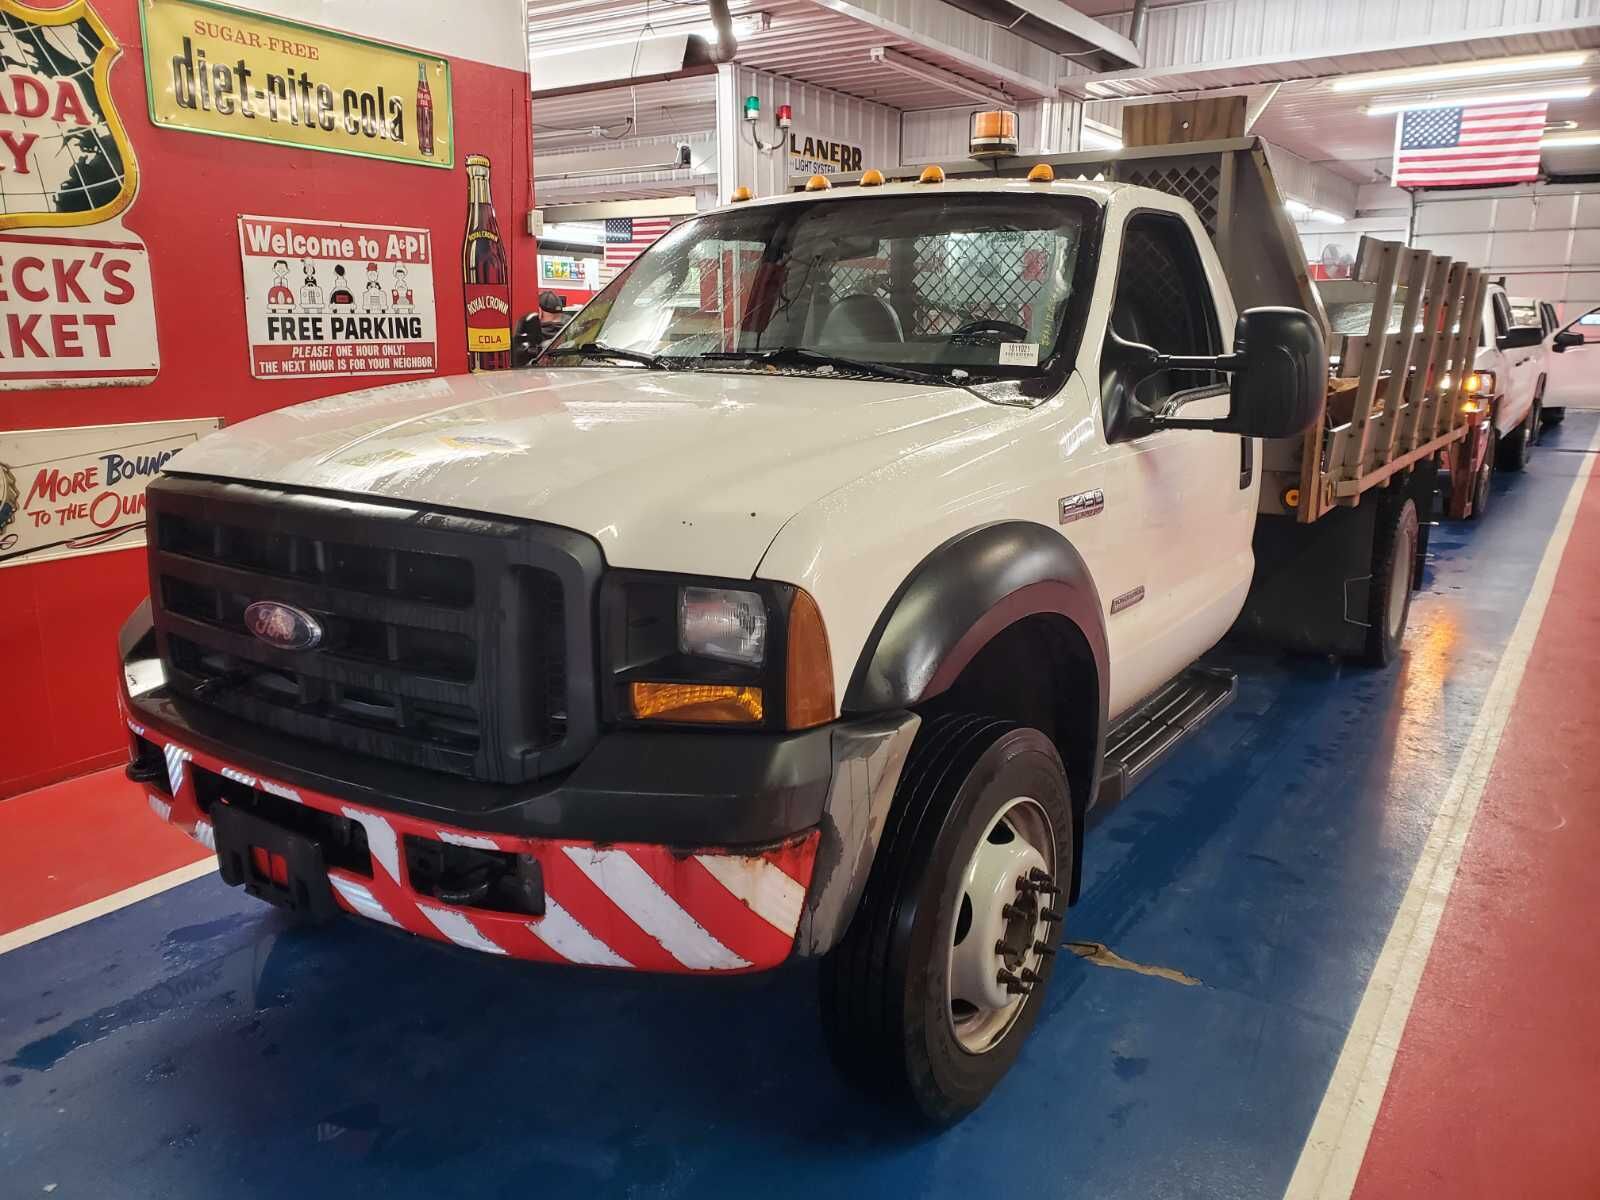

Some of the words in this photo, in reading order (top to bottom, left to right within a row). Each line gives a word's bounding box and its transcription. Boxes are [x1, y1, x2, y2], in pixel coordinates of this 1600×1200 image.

[194, 20, 319, 61] SUGAR-FREE
[172, 35, 336, 132] diet-rite
[342, 86, 404, 142] cola
[795, 158, 813, 171] LIGHT
[813, 161, 836, 174] SYSTEM
[246, 224, 354, 258] Welcome
[358, 235, 380, 259] to
[385, 234, 426, 260] A&P!
[0, 252, 135, 305] CK'S
[467, 296, 486, 315] ROYAL
[485, 295, 509, 316] CROWN
[0, 314, 116, 358] KET
[267, 316, 324, 341] FREE
[331, 316, 422, 340] PARKING
[478, 335, 502, 344] COLA
[259, 361, 278, 373] THE
[282, 360, 305, 372] NEXT
[309, 359, 334, 371] HOUR
[337, 359, 347, 370] IS
[350, 358, 366, 370] FOR
[368, 358, 390, 369] YOUR
[393, 356, 433, 369] NEIGHBOR
[292, 345, 333, 358] PLEASE!
[335, 345, 352, 357] ONE
[356, 345, 379, 356] HOUR
[382, 344, 406, 356] ONLY!
[23, 466, 99, 510] MORE
[99, 448, 183, 486] BOUN
[28, 510, 51, 528] TO
[55, 503, 88, 525] THE
[89, 491, 147, 528] OUN
